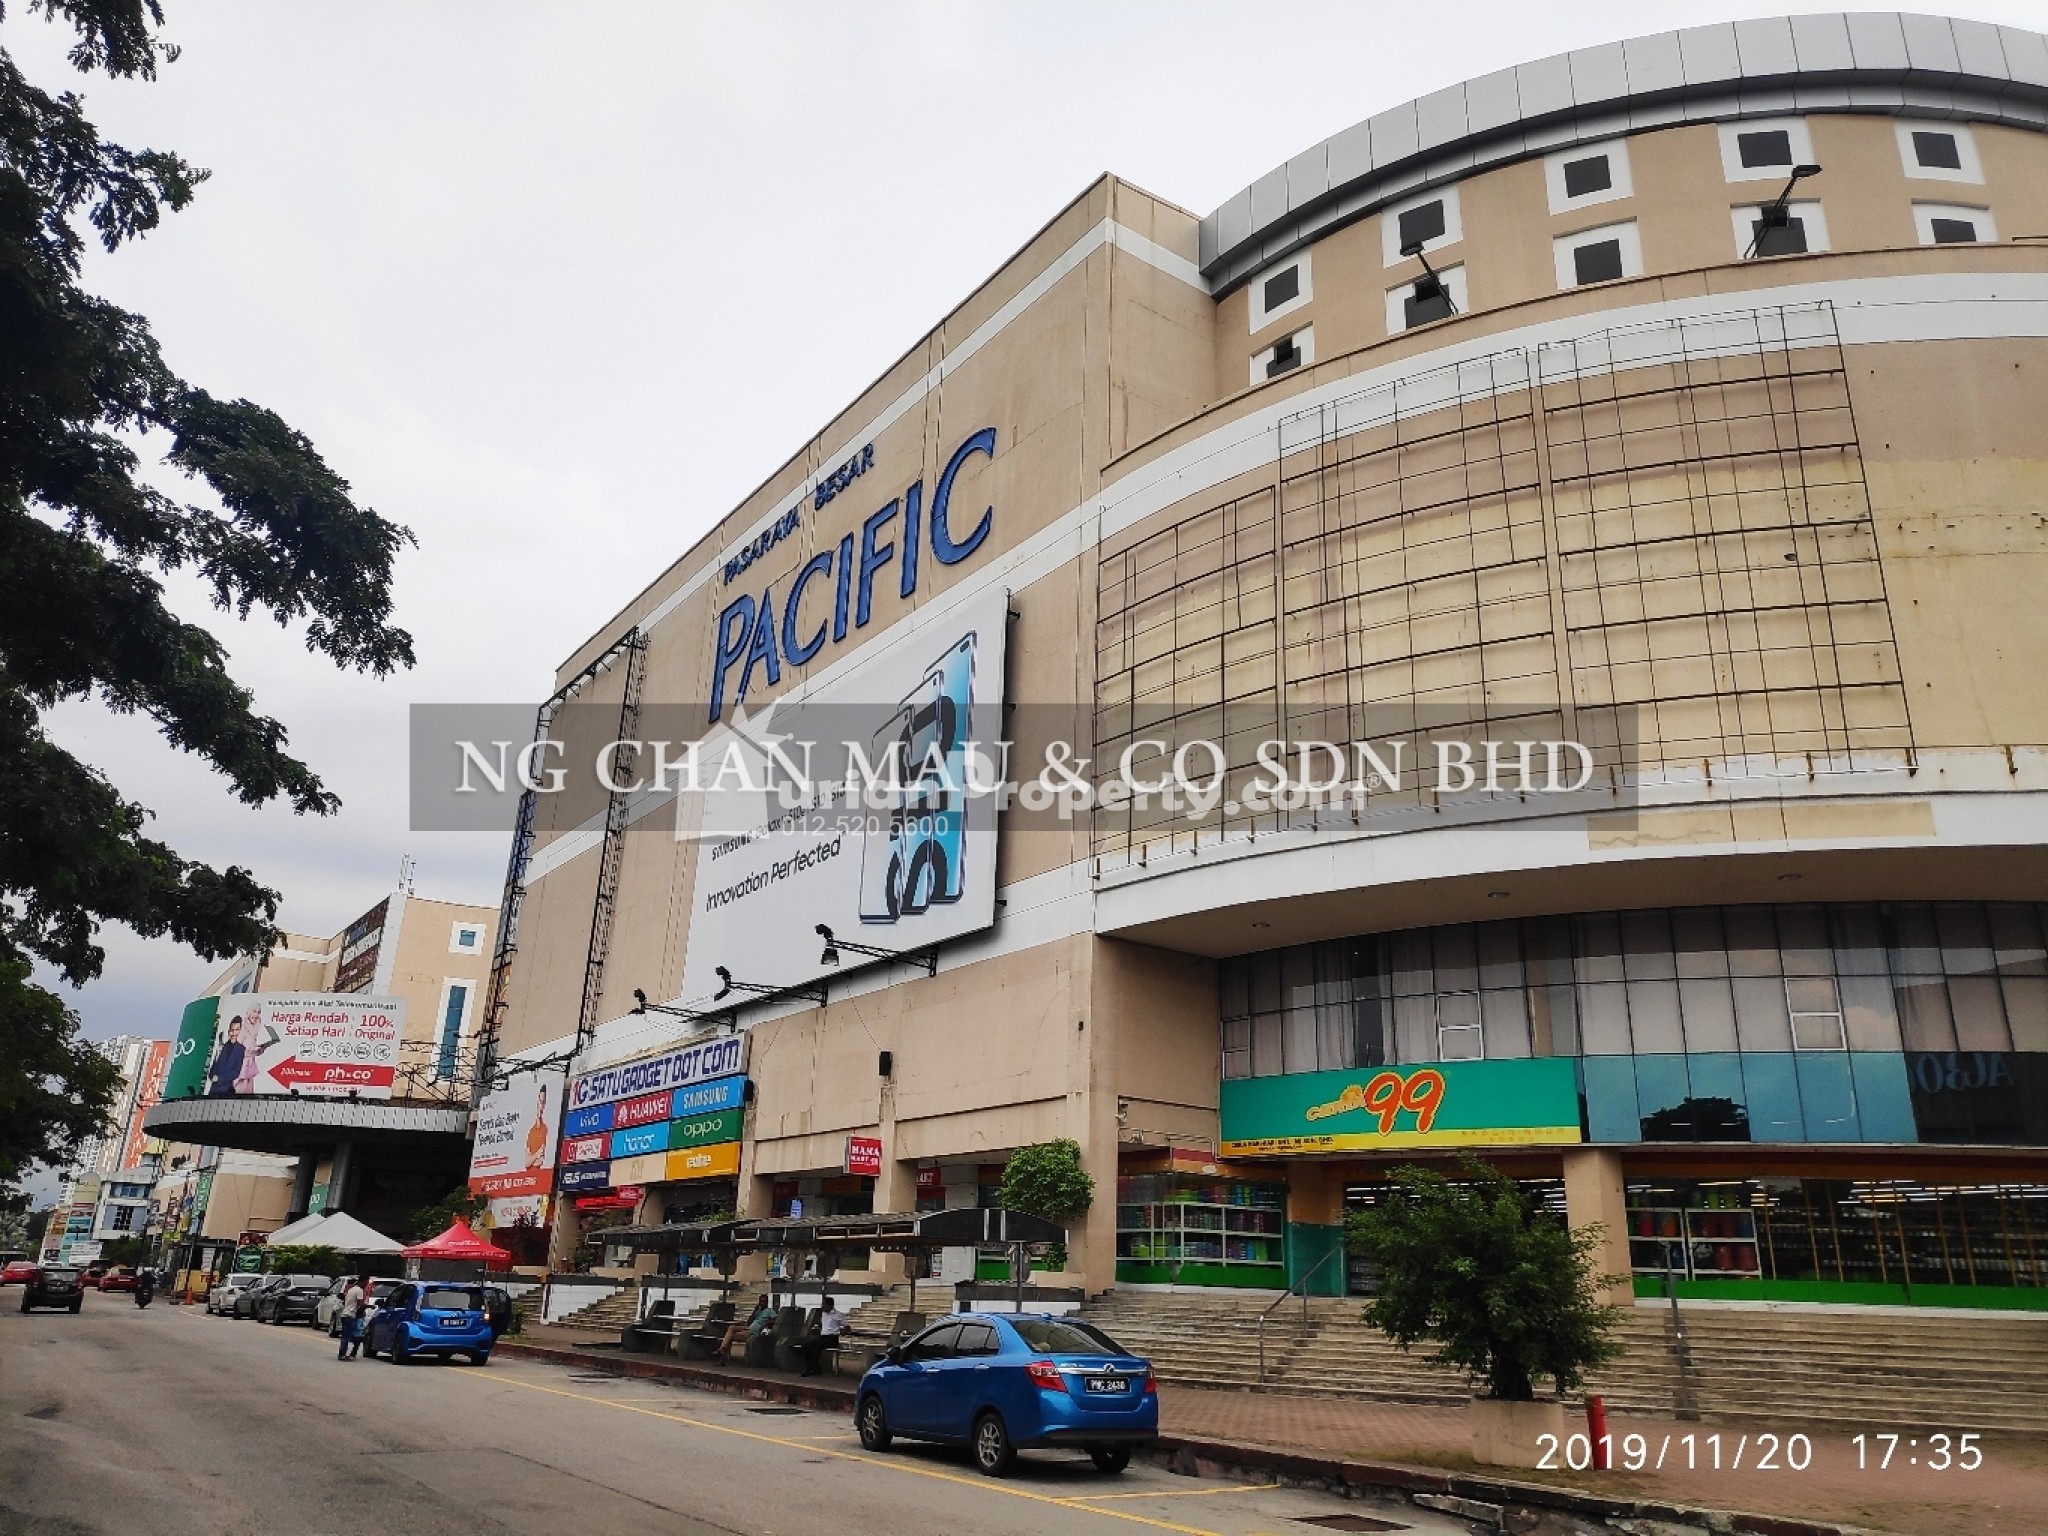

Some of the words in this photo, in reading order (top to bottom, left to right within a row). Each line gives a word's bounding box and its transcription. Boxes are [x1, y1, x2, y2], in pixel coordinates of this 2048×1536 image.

[723, 508, 801, 585] PASARAYA
[813, 443, 875, 510] BESAR
[708, 427, 997, 723] PACIFIC
[706, 867, 769, 913] Innovation
[771, 834, 842, 885] Perfected
[271, 1011, 301, 1024] Harga
[304, 1012, 349, 1024] Rendah
[359, 1014, 394, 1029] 100%
[285, 1026, 319, 1038] Setiap
[322, 1026, 346, 1038] Hari
[354, 1028, 396, 1041] Original
[702, 1040, 740, 1075] COM
[629, 1097, 670, 1121] HUAWEI
[683, 1086, 729, 1110] SAMSUNG
[1364, 1069, 1446, 1137] 99
[580, 1111, 600, 1129] vivo
[624, 1133, 655, 1153] honor
